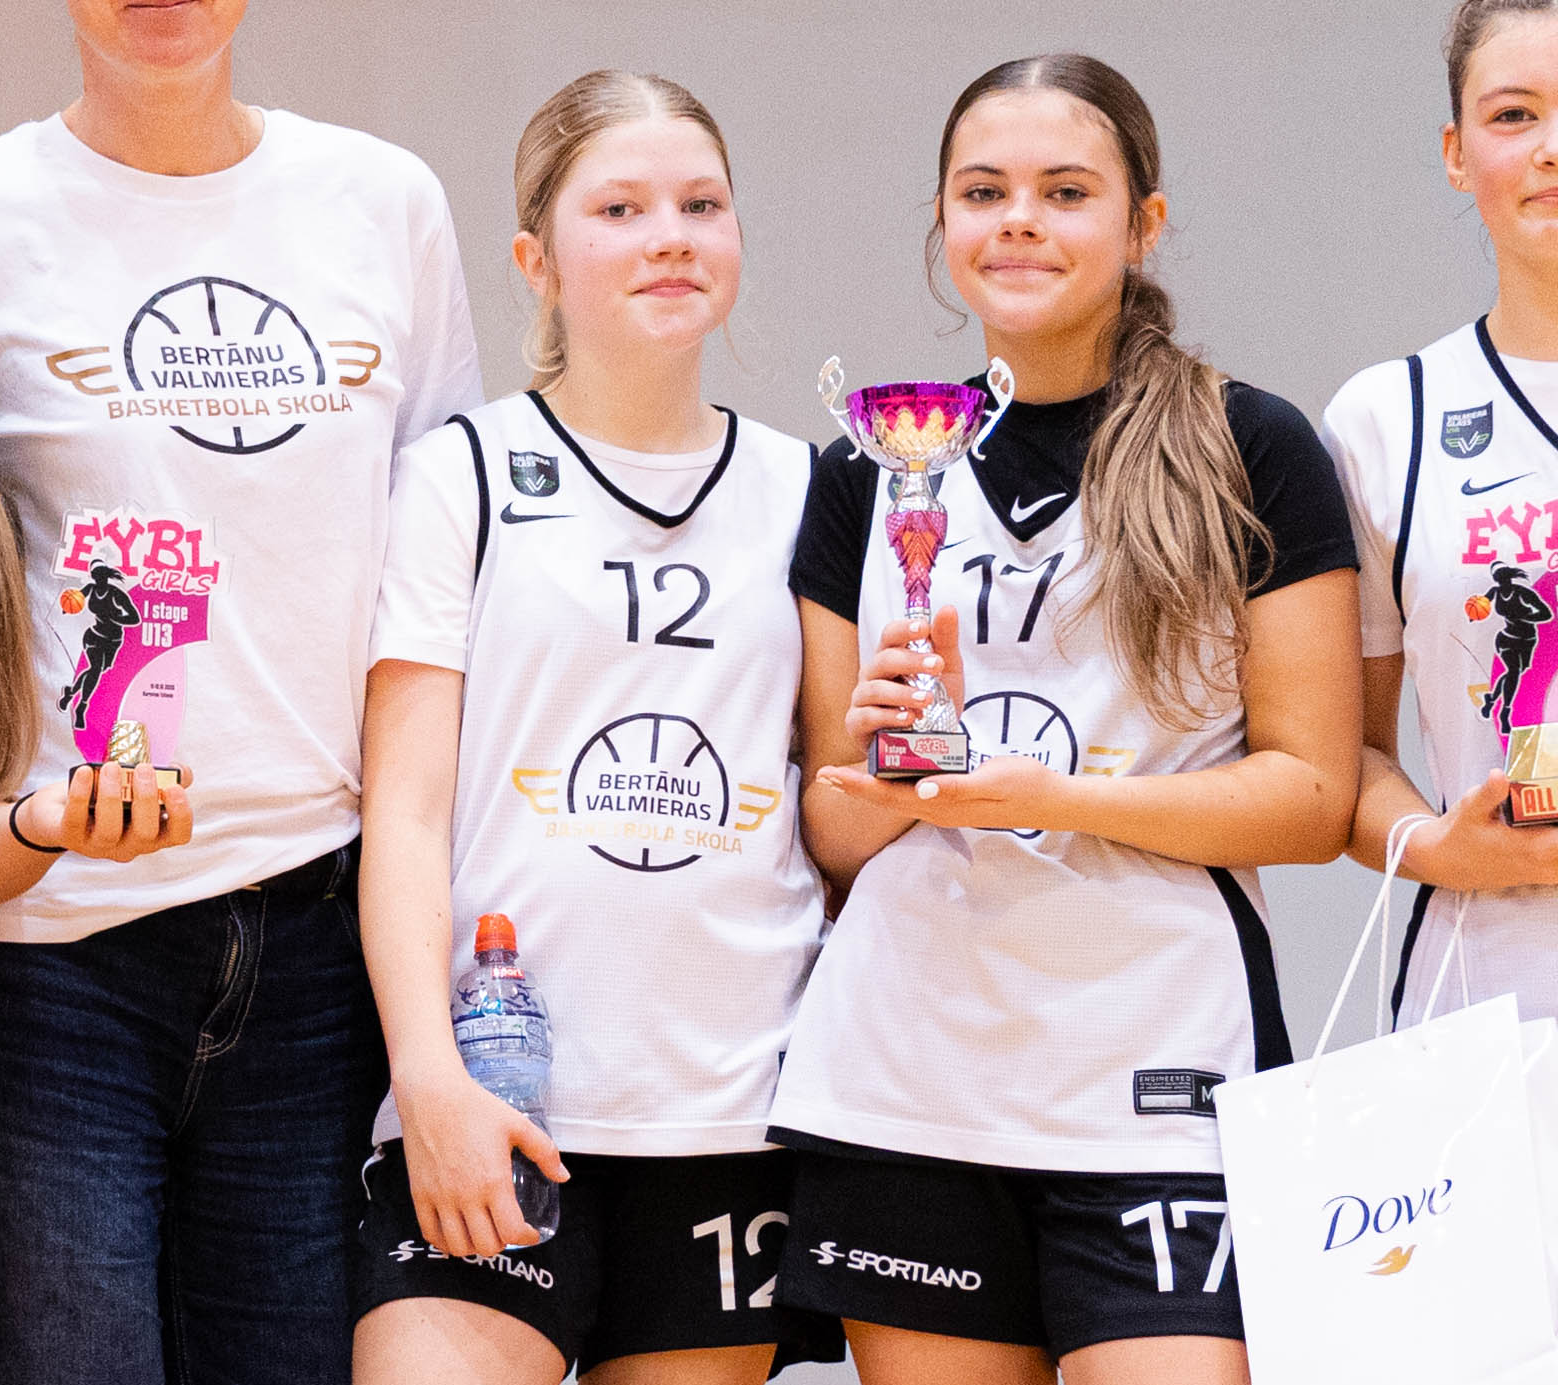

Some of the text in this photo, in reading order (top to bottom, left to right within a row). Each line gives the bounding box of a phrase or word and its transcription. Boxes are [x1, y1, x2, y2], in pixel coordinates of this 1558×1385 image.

[160, 342, 285, 367] BERTĀNU
[151, 365, 305, 390] VALMIERAS
[107, 392, 353, 420] BASKETBOLA SKOLA
[62, 515, 221, 585] EYBL
[141, 569, 214, 594] GIRLS
[152, 601, 189, 622] stage
[603, 560, 715, 649] 12
[961, 551, 1065, 645] 17
[142, 622, 174, 647] U13
[598, 770, 702, 797] BERTĀNU
[586, 793, 712, 821] VALMIERAS
[1520, 785, 1555, 817] ALL
[685, 830, 743, 855] SKOLA
[1201, 1085, 1216, 1104] M
[1321, 1178, 1453, 1251] Dove
[693, 1210, 790, 1311] 12
[1122, 1201, 1232, 1293] 17
[846, 1249, 982, 1291] SPORTLAND
